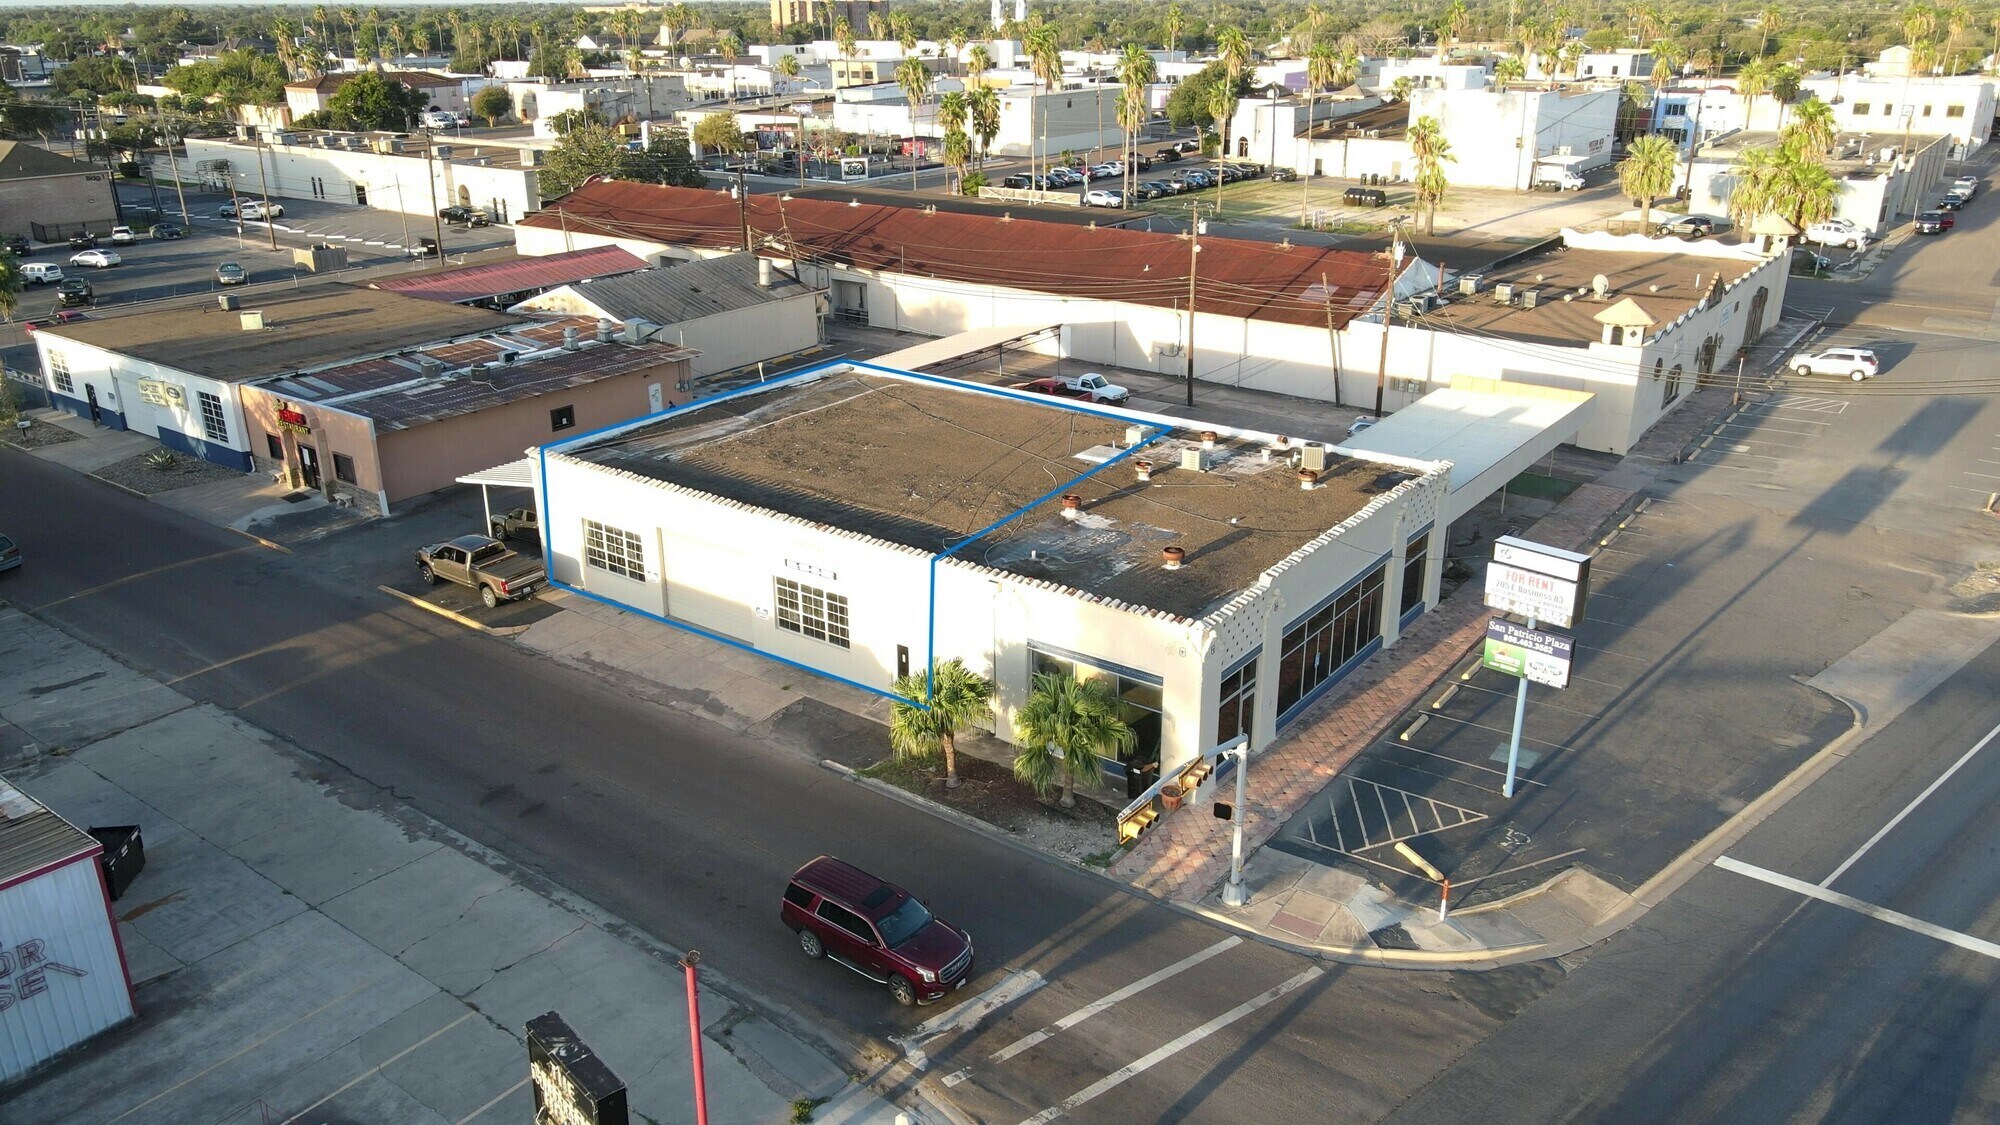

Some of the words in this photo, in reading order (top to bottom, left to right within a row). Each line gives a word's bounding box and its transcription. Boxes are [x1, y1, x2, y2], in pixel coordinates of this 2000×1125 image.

[1506, 570, 1526, 586] FOR
[1528, 576, 1555, 592] RENT
[1518, 585, 1552, 602] Business
[1488, 620, 1506, 633] San
[1508, 625, 1543, 643] Patricio
[1545, 636, 1570, 651] Plaza
